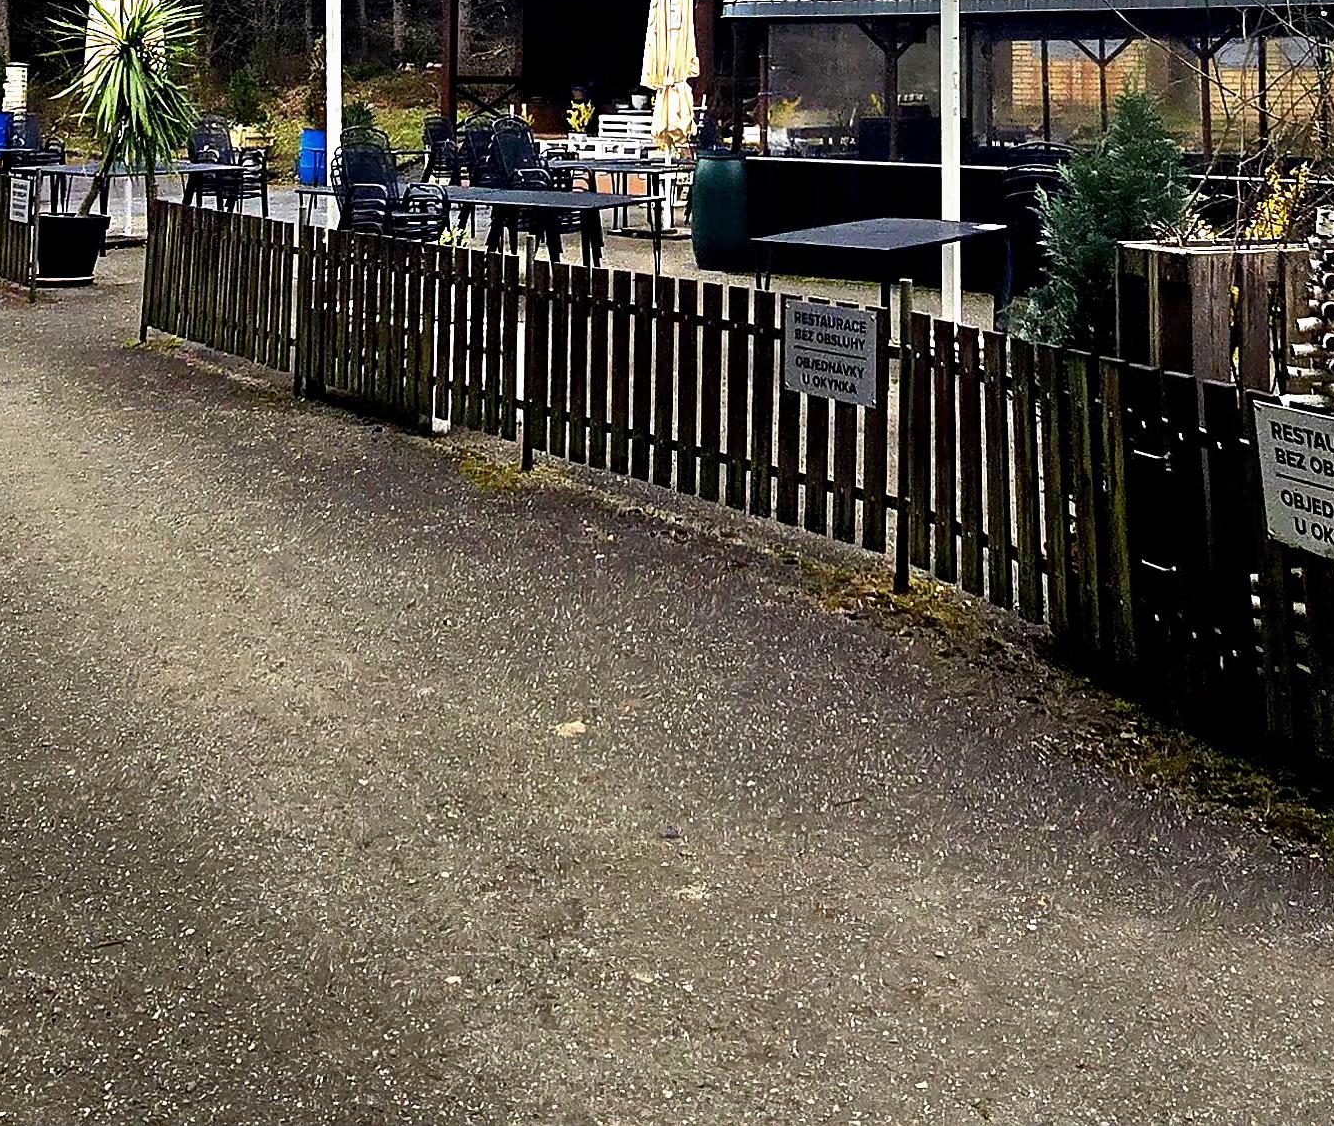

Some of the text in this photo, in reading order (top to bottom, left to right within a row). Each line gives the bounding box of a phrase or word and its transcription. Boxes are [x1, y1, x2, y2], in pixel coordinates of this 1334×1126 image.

[794, 311, 866, 334] RESTAURACE
[794, 328, 865, 351] BEZ OBSLUHY
[802, 373, 811, 385] U
[1274, 447, 1307, 471] BEZ
[1293, 516, 1307, 535] U
